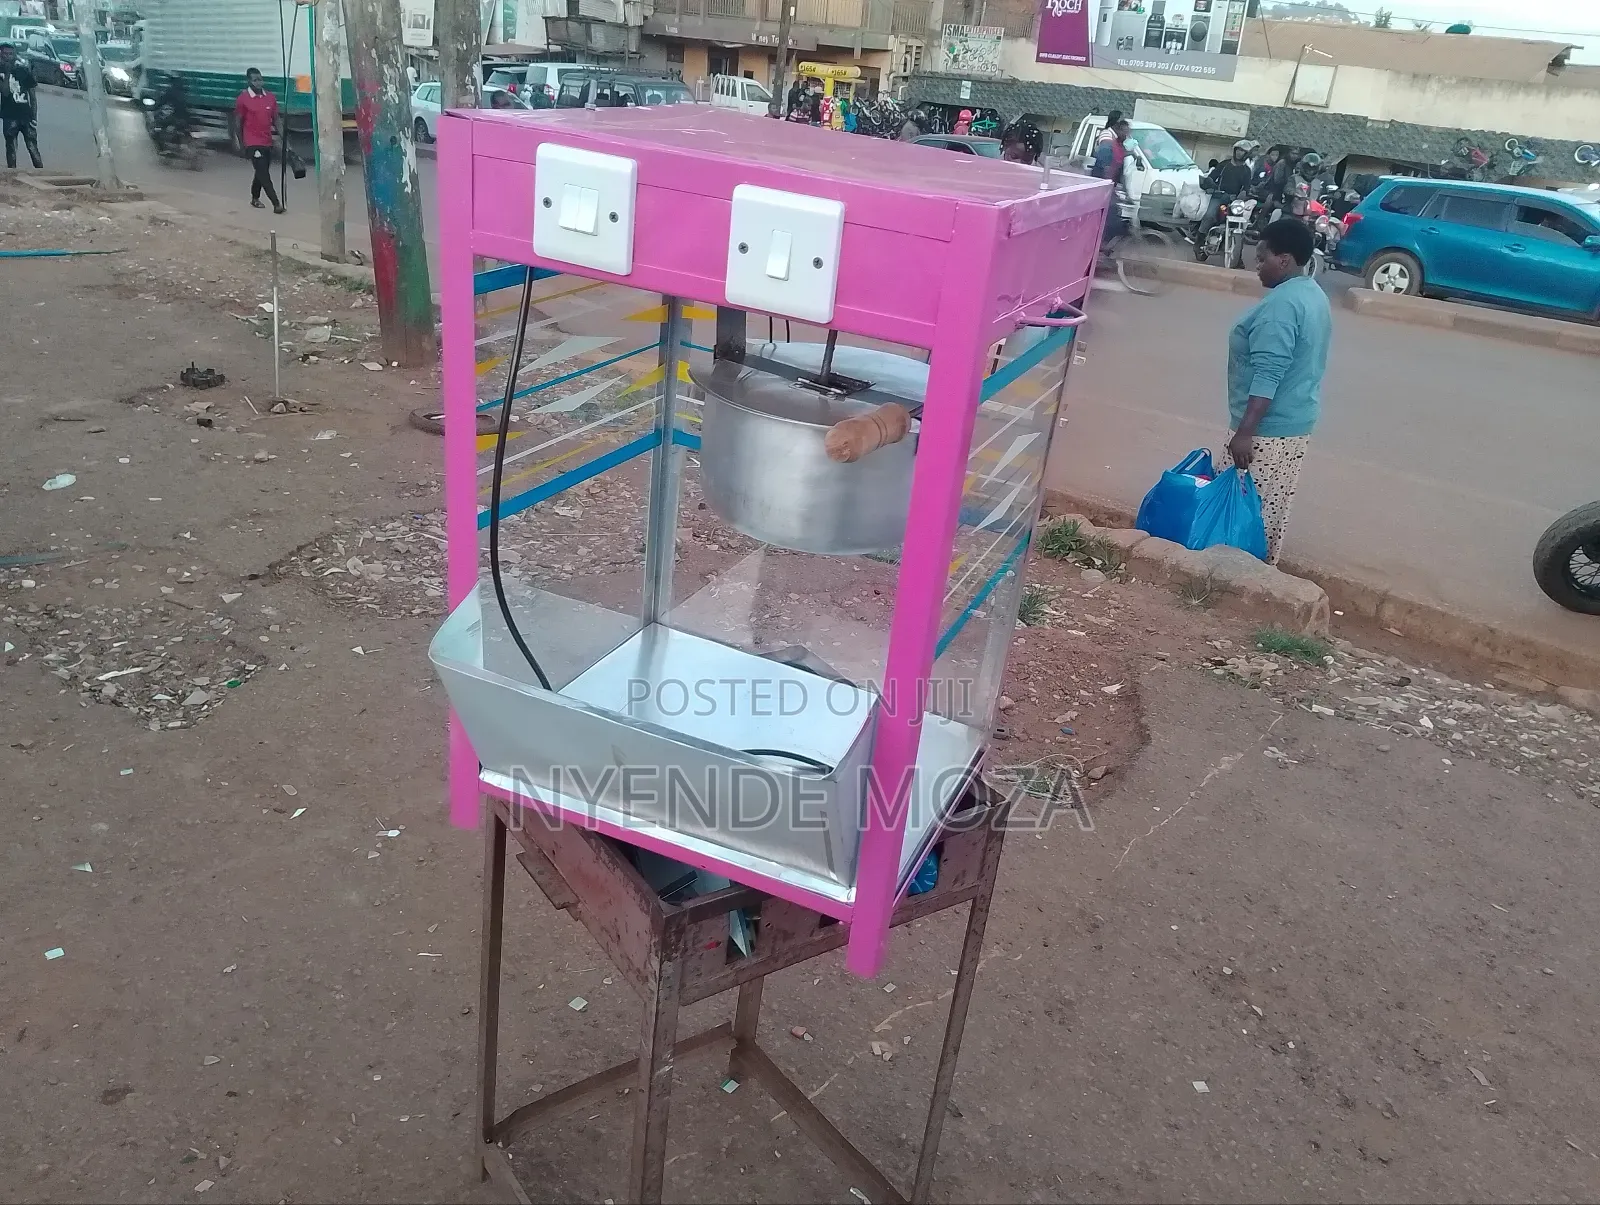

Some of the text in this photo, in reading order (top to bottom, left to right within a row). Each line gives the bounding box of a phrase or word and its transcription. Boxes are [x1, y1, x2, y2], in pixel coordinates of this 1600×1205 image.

[944, 24, 964, 37] ISMA
[1117, 58, 1129, 66] TEL:
[1129, 59, 1144, 67] 0705
[1169, 62, 1174, 71] /
[1174, 64, 1189, 72] 0774
[1190, 65, 1202, 73] 922
